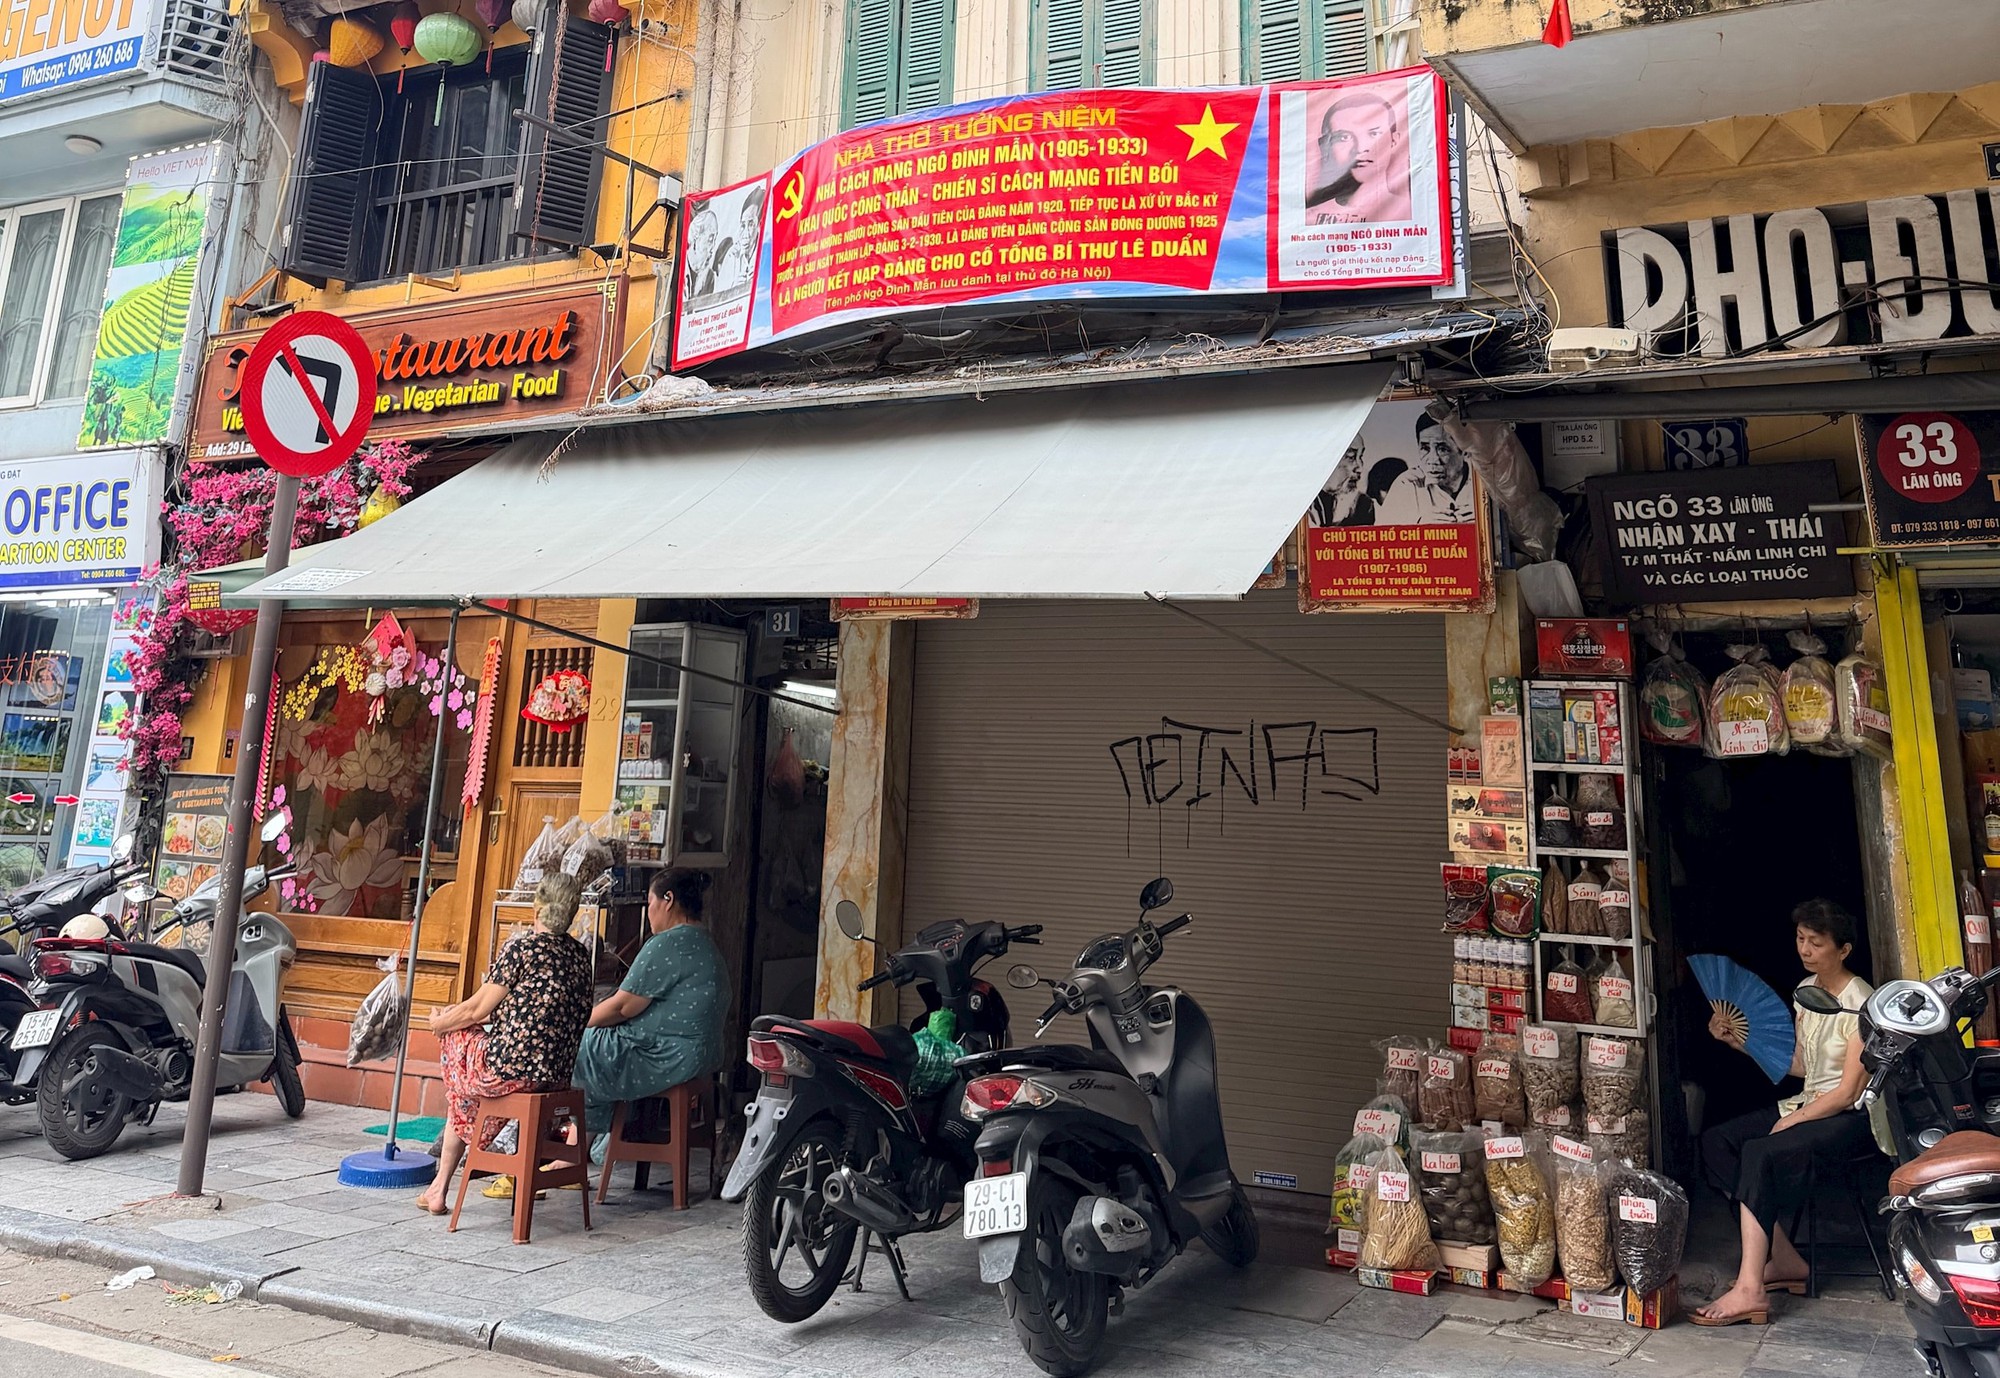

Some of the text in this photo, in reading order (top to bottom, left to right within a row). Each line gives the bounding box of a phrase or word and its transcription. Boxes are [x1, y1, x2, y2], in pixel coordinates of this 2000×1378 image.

[22, 61, 66, 88] Whatsap:
[68, 50, 93, 76] 0904
[94, 45, 112, 69] 260
[115, 40, 134, 64] 686
[1043, 104, 1116, 131] NIỆM
[137, 166, 160, 178] Hello
[163, 161, 183, 174] VIET
[840, 168, 870, 193] CÁCH
[873, 160, 912, 185] MẠNG
[917, 151, 947, 174] NGÔ
[995, 138, 1034, 163] MẪN
[1040, 137, 1148, 161] (1905-1933)
[798, 214, 819, 236] KHAI
[822, 206, 848, 227] QUỐC
[851, 193, 881, 217] CÔNG
[932, 174, 977, 201] CHIẾN
[981, 172, 997, 195] SĨ
[1001, 169, 1044, 193] CÁCH
[1049, 168, 1100, 191] MẠNG
[1149, 160, 1179, 183] BỐI
[932, 210, 953, 225] TIÊN
[956, 205, 975, 222] CỦA
[978, 202, 1006, 220] ĐẢNG
[1009, 201, 1034, 216] NĂM
[1037, 200, 1066, 213] 1920.
[1070, 195, 1093, 212] TIẾP
[1097, 197, 1118, 213] TỤC
[1122, 195, 1136, 210] LÀ
[1140, 193, 1156, 209] XỨ
[1158, 191, 1172, 208] ỦY
[1176, 191, 1200, 207] BẮC
[1351, 228, 1372, 239] NGÔ
[1375, 228, 1400, 238] ĐÌNH
[1326, 242, 1392, 253] (1905-1933)
[779, 289, 790, 307] LÀ
[827, 267, 850, 292] KẾT
[853, 264, 880, 286] NẠP
[884, 256, 926, 279] ĐẢNG
[931, 252, 964, 272] CHO
[970, 243, 994, 267] CỐ
[999, 241, 1047, 264] TỔNG
[1053, 240, 1073, 261] BÍ
[1079, 241, 1118, 260] THƯ
[1122, 238, 1145, 258] LÊ
[1151, 233, 1208, 257] DUẨN
[845, 289, 861, 306] phố
[864, 286, 883, 303] Ngô
[940, 276, 958, 289] lưu
[961, 273, 991, 286] danh
[996, 272, 1011, 284] tại
[1015, 268, 1036, 281] thủ
[1040, 268, 1057, 280] đô
[1061, 266, 1079, 279] Hà
[1083, 266, 1111, 280] Nội)
[511, 370, 559, 398] Food
[206, 443, 227, 457] Add:
[227, 442, 239, 455] 29
[1581, 435, 1593, 443] 5.2
[1896, 422, 1958, 467] 33
[1902, 471, 1962, 490] LÃN ÔNG
[5, 481, 130, 535] OFFICE
[1613, 494, 1679, 521] NGÕ
[1687, 496, 1724, 517] 33
[1322, 527, 1458, 545] CHỦ TỊCH HỒ CHÍ MINH
[1617, 513, 1824, 549] NHẬN XAY THÁI
[1891, 524, 1904, 533] ĐT:
[1905, 522, 1920, 533] 079
[1922, 522, 1937, 531] 333
[1940, 520, 1960, 530] 1818
[1967, 519, 1982, 529] 097
[63, 536, 126, 563] CENTER
[1315, 543, 1468, 561] VỚI TỔNG BÍ THƯ LÊ DUẨN
[1756, 547, 1794, 561] LINH
[1798, 545, 1827, 558] CHI
[1359, 564, 1428, 574] (1907-1986)
[1643, 563, 1809, 585] VÀ CÁC LOẠI THUỐC
[1371, 587, 1399, 597] CỘNG
[1424, 587, 1445, 596] VIỆT
[1449, 587, 1472, 595] NAM
[773, 612, 791, 632] 31
[591, 695, 621, 721] 29
[27, 1012, 55, 1030] 15-AF
[16, 1028, 52, 1046] 253.06
[1069, 1078, 1094, 1090] SH
[974, 1178, 1015, 1207] 29-C1
[969, 1204, 1021, 1234] 780.13
